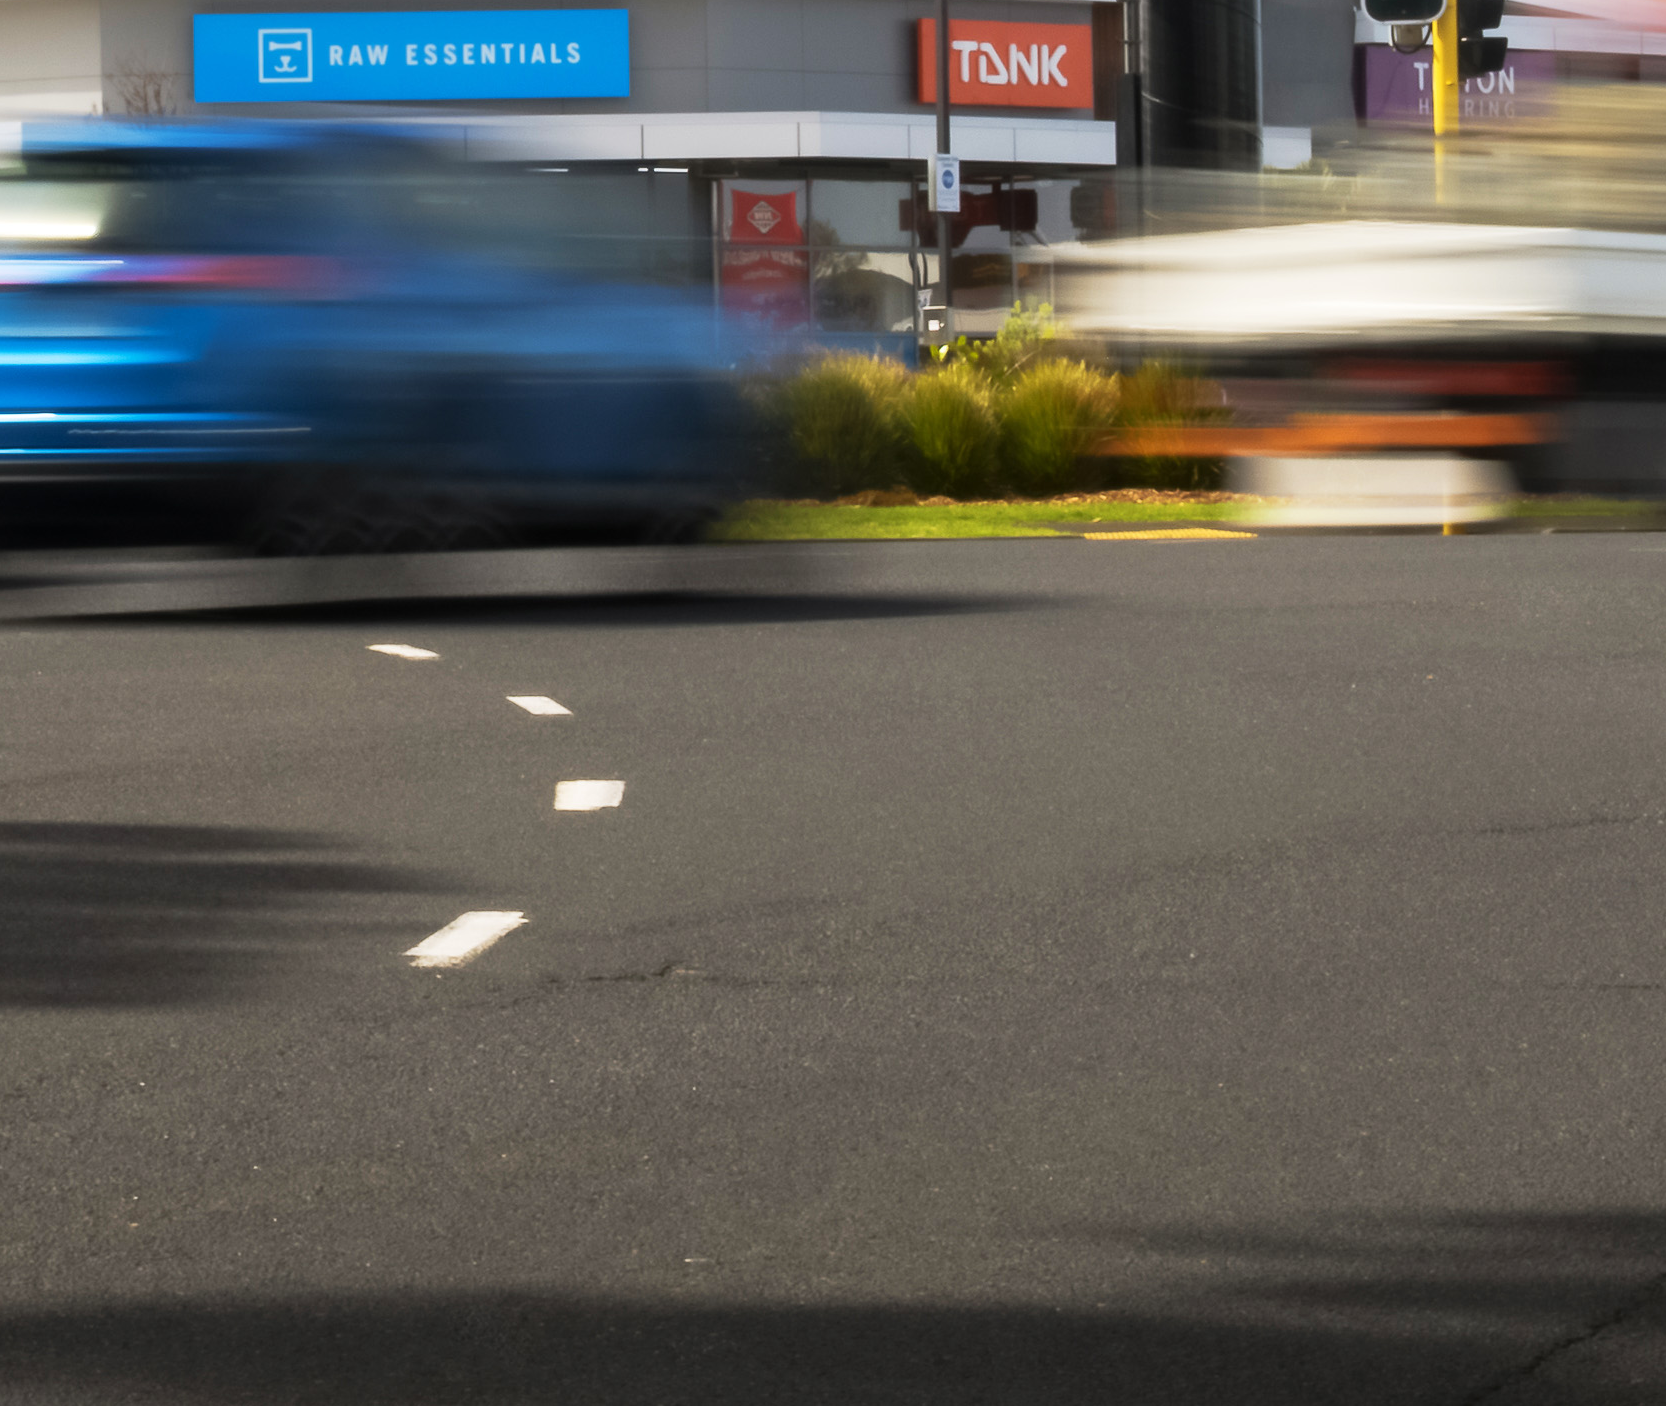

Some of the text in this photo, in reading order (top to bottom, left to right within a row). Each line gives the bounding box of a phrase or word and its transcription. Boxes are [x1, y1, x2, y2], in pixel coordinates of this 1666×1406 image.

[329, 42, 581, 66] RAW ESSENTIALS
[952, 40, 1068, 87] TANK
[1419, 97, 1516, 118] HRING
